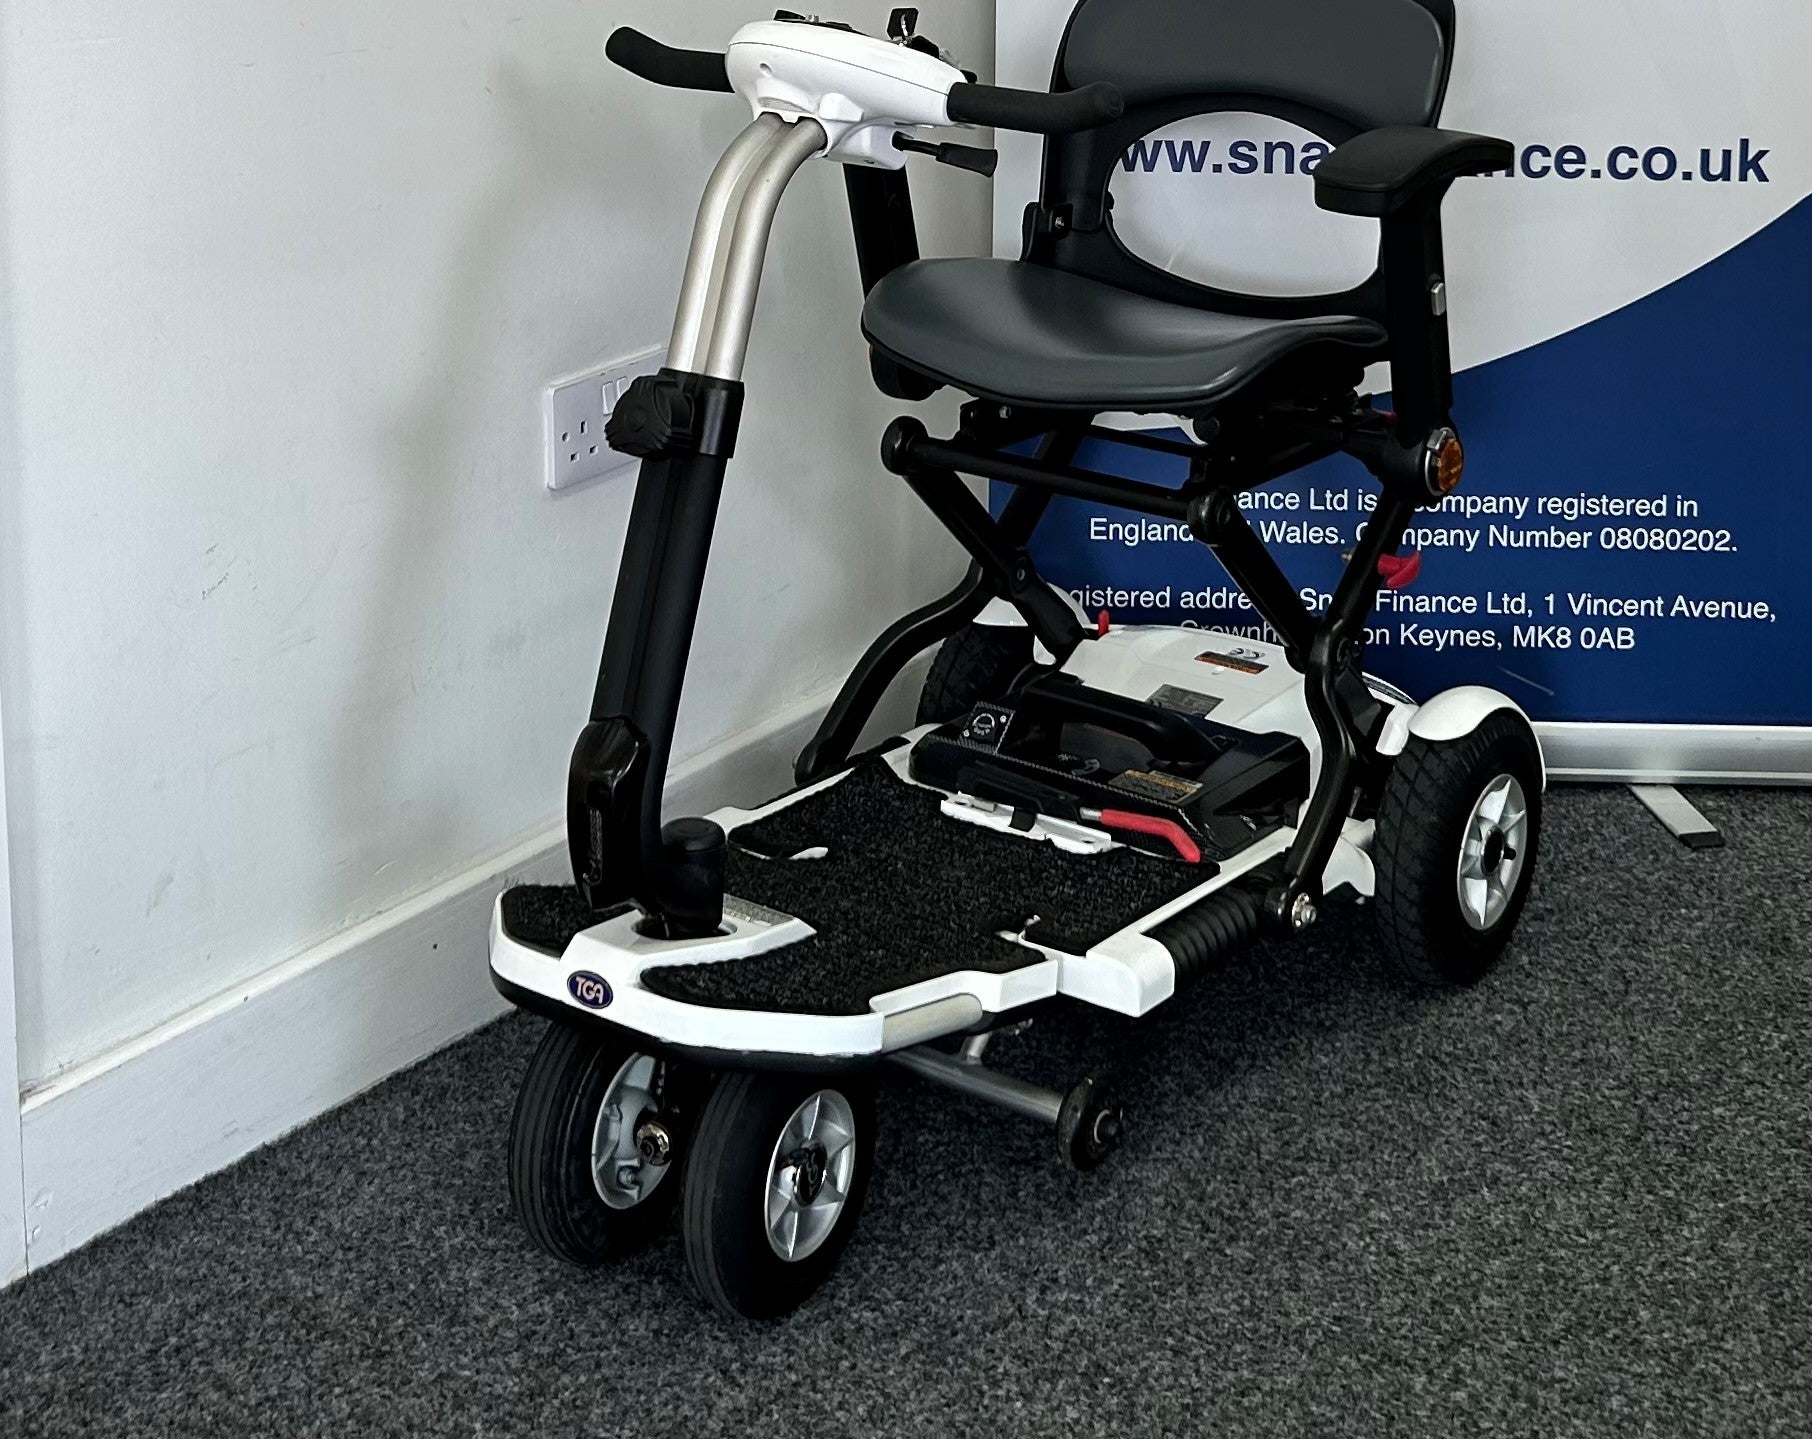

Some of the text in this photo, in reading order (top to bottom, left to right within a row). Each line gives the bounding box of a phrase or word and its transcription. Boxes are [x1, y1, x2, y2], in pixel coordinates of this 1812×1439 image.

[1309, 487, 1349, 511] Ltd
[1357, 488, 1378, 512] is
[1537, 492, 1667, 521] registered
[1676, 494, 1698, 517] in
[1259, 520, 1346, 544] Wales.
[1488, 524, 1593, 549] Number
[1599, 527, 1738, 552] 08080202.
[1375, 589, 1478, 614] Finance
[1487, 591, 1533, 618] Ltd,
[1544, 593, 1555, 615] 1
[1567, 592, 1664, 617] Vincent
[1669, 594, 1776, 622] Avenue,
[1400, 623, 1503, 652] Keynes,
[1513, 625, 1572, 649] MK8
[1580, 627, 1636, 650] 0AB
[575, 975, 605, 1005] TGA
